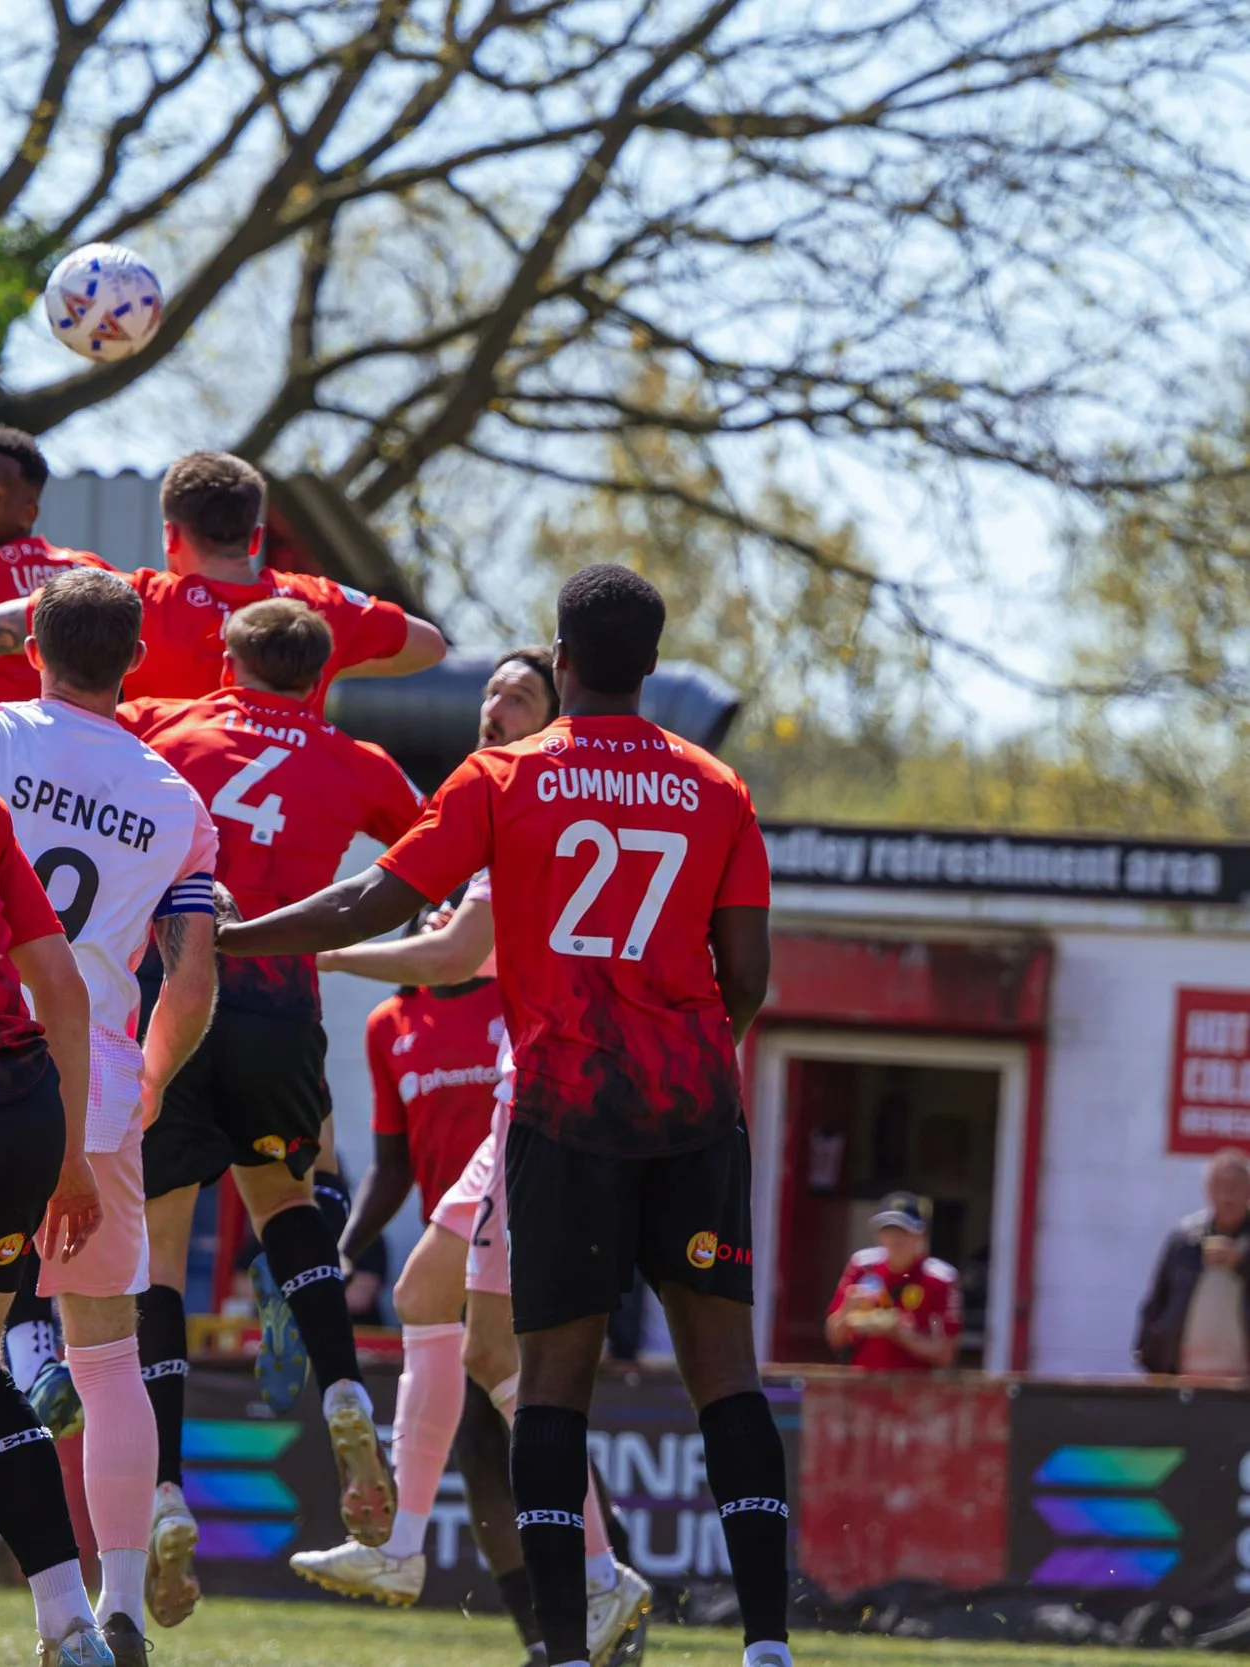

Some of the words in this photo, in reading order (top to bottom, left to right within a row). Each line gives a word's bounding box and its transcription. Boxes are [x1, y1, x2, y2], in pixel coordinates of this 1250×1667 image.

[575, 736, 684, 754] RAYDIUM
[210, 745, 292, 846] 4
[537, 767, 699, 811] CUMMINGS
[11, 775, 156, 853] SPENCER
[33, 847, 99, 944] 9
[549, 819, 688, 961] 27
[421, 1065, 500, 1096] phanto
[282, 1265, 345, 1298] REDS
[515, 1509, 585, 1529] REDS
[720, 1497, 790, 1518] REDS
